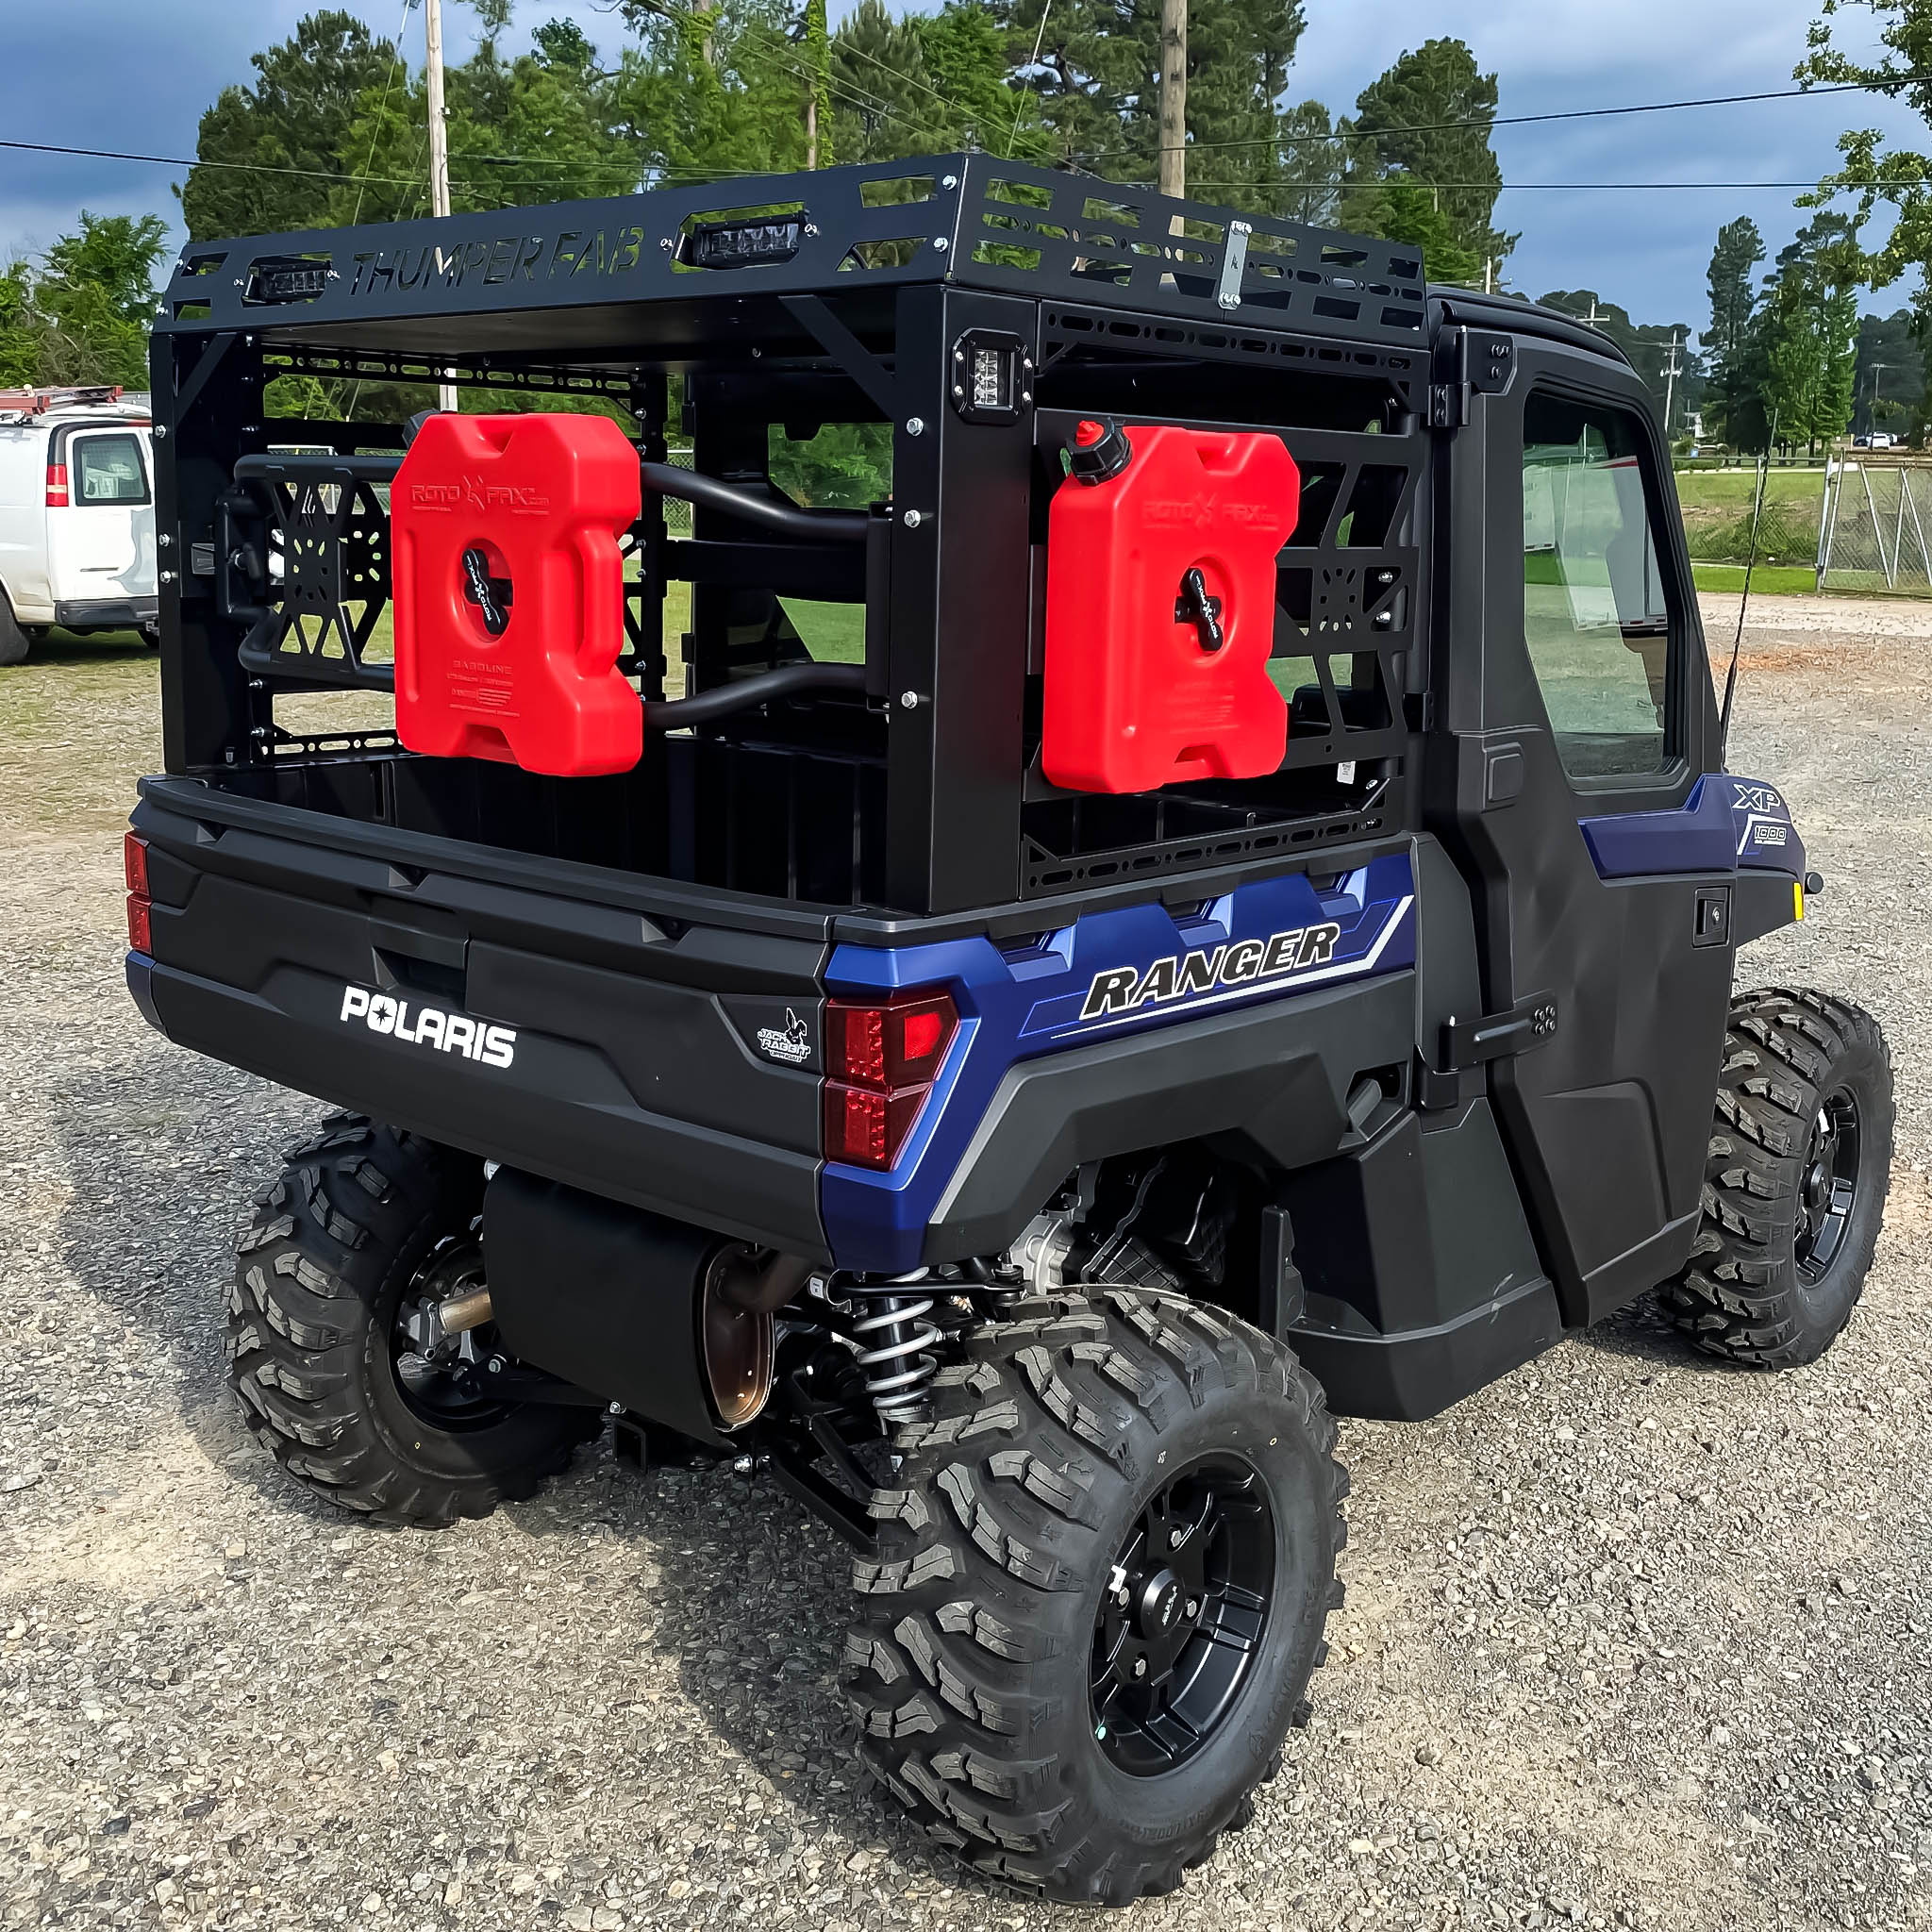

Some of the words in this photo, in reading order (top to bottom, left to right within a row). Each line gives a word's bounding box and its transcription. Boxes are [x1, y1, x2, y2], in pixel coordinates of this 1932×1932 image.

[348, 235, 544, 296] THUMPER
[546, 225, 645, 281] FAB
[1732, 783, 1781, 812] XP
[1754, 824, 1788, 841] 1000
[1078, 921, 1341, 1021] RANGER
[340, 985, 518, 1069] POLARIS
